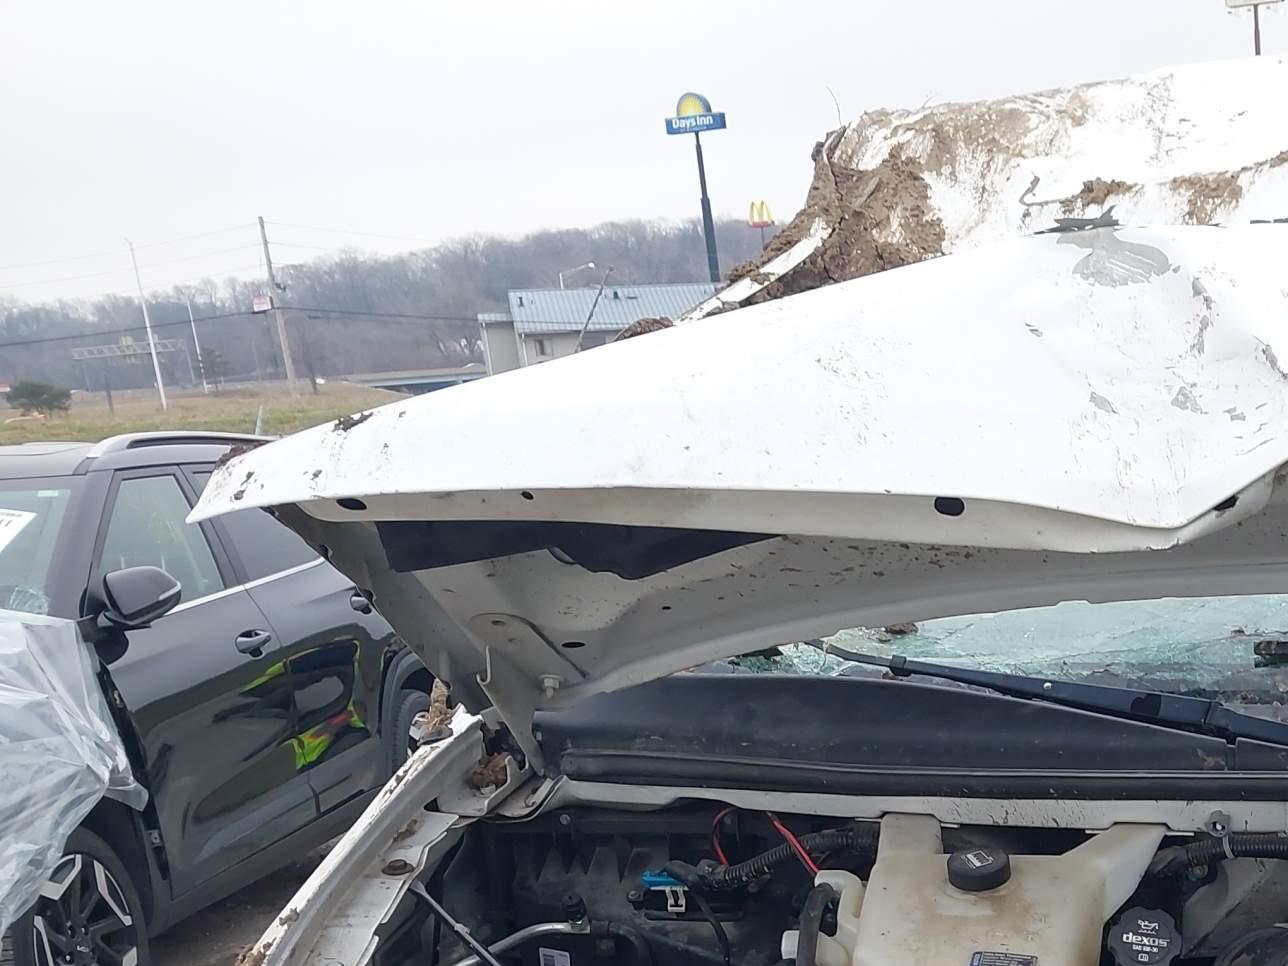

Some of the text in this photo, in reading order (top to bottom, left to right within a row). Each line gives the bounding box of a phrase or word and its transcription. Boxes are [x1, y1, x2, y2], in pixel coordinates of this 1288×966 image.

[672, 118, 696, 130] Days
[696, 115, 713, 126] Inn
[1122, 932, 1170, 947] dexos
